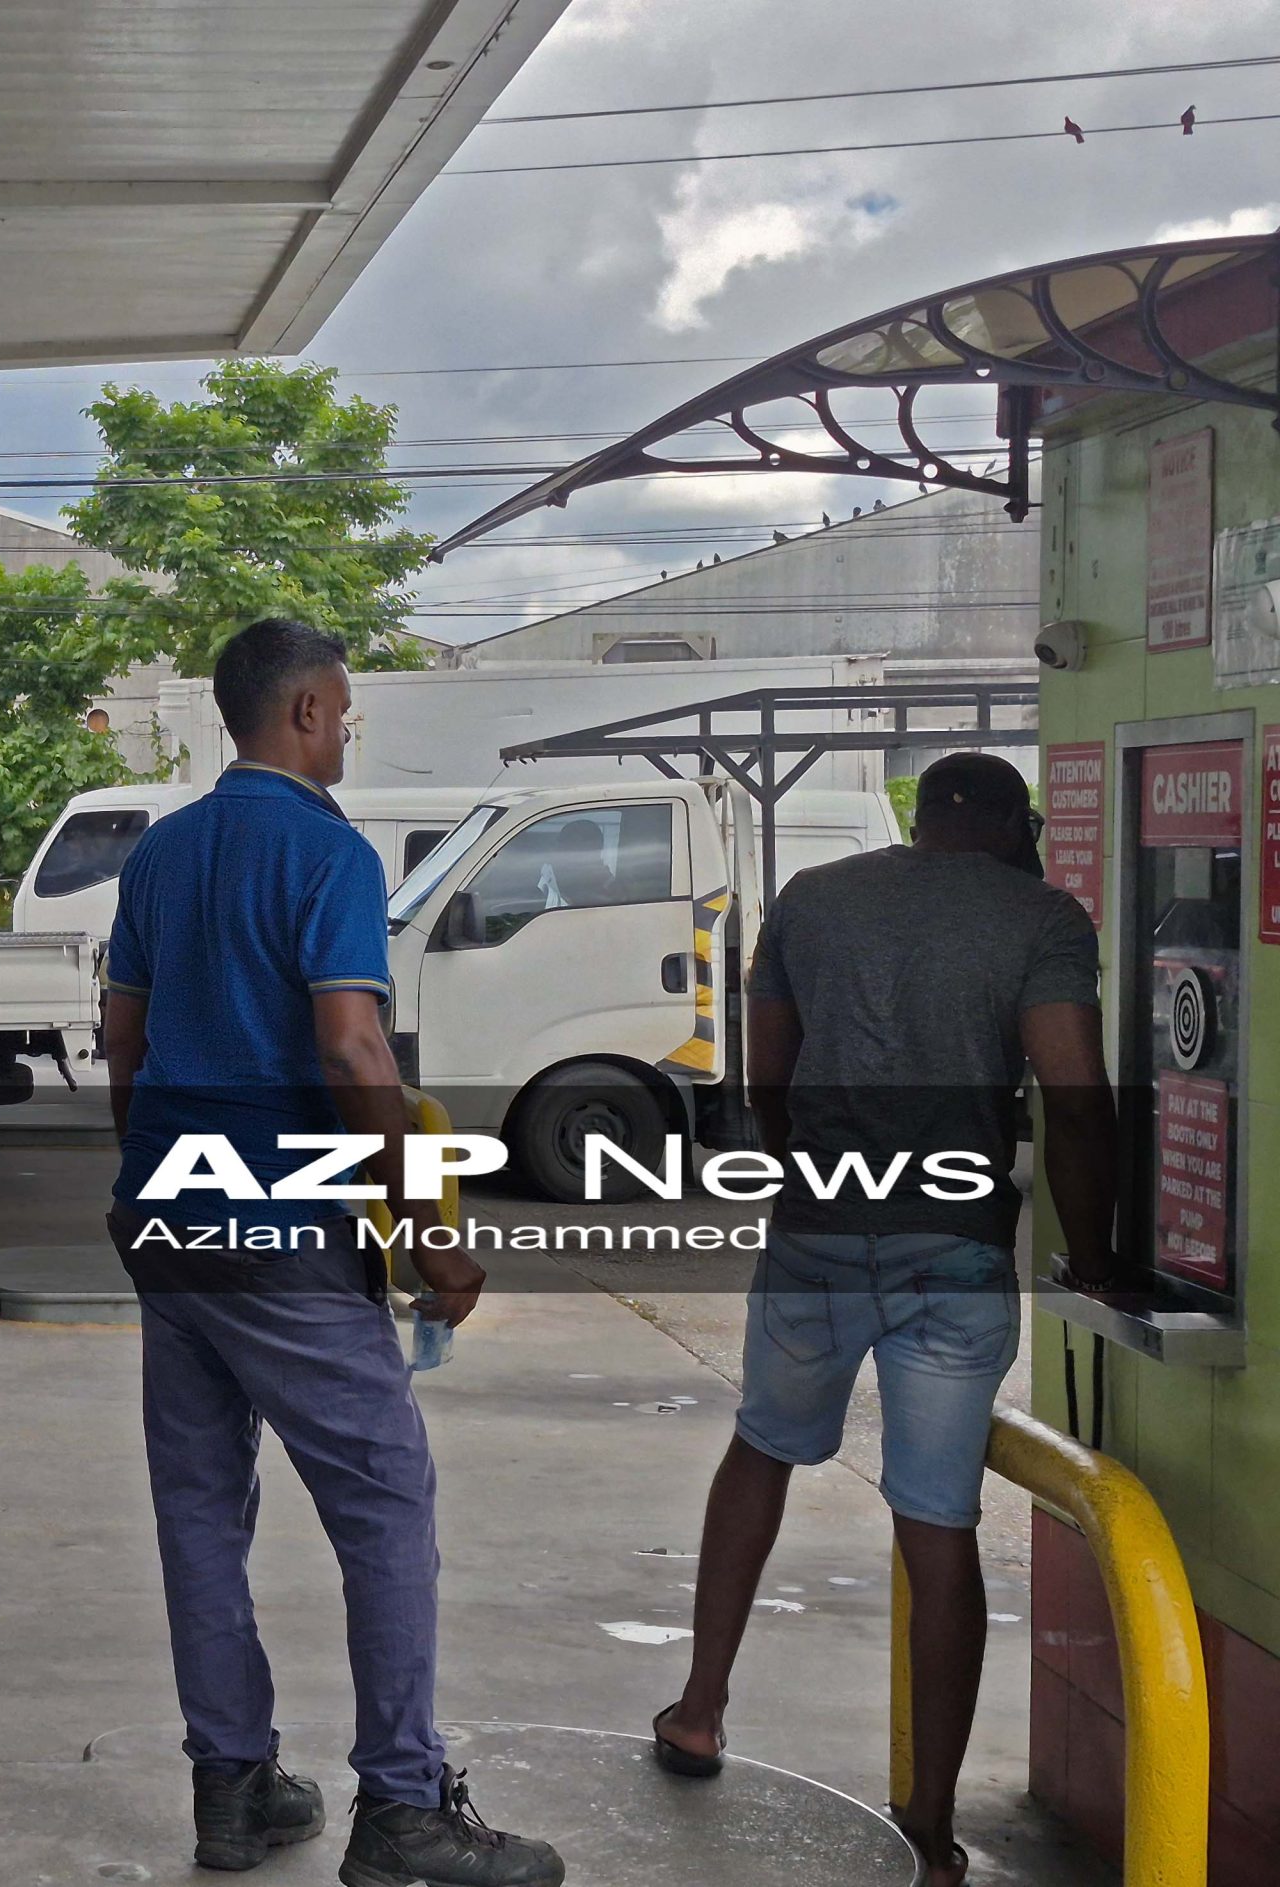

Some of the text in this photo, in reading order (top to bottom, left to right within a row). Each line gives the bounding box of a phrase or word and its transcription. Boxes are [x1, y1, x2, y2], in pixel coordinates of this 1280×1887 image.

[1049, 759, 1102, 784] ATTENTION
[1052, 788, 1099, 809] CUSTOMERS
[1152, 770, 1232, 815] CASHIER
[1050, 825, 1098, 842] PLEASE DO NOT
[1055, 850, 1094, 866] LEAVE YOUR
[1065, 873, 1083, 889] CASH
[1168, 1093, 1218, 1123] PAY AT THE
[1167, 1122, 1218, 1151] BOOTH ONLY
[1162, 1149, 1222, 1181] WHEN YOU ARE
[1161, 1175, 1221, 1209] PARKED AT THE
[1180, 1208, 1203, 1230] PUMP
[1185, 1237, 1217, 1264] BEFORE
